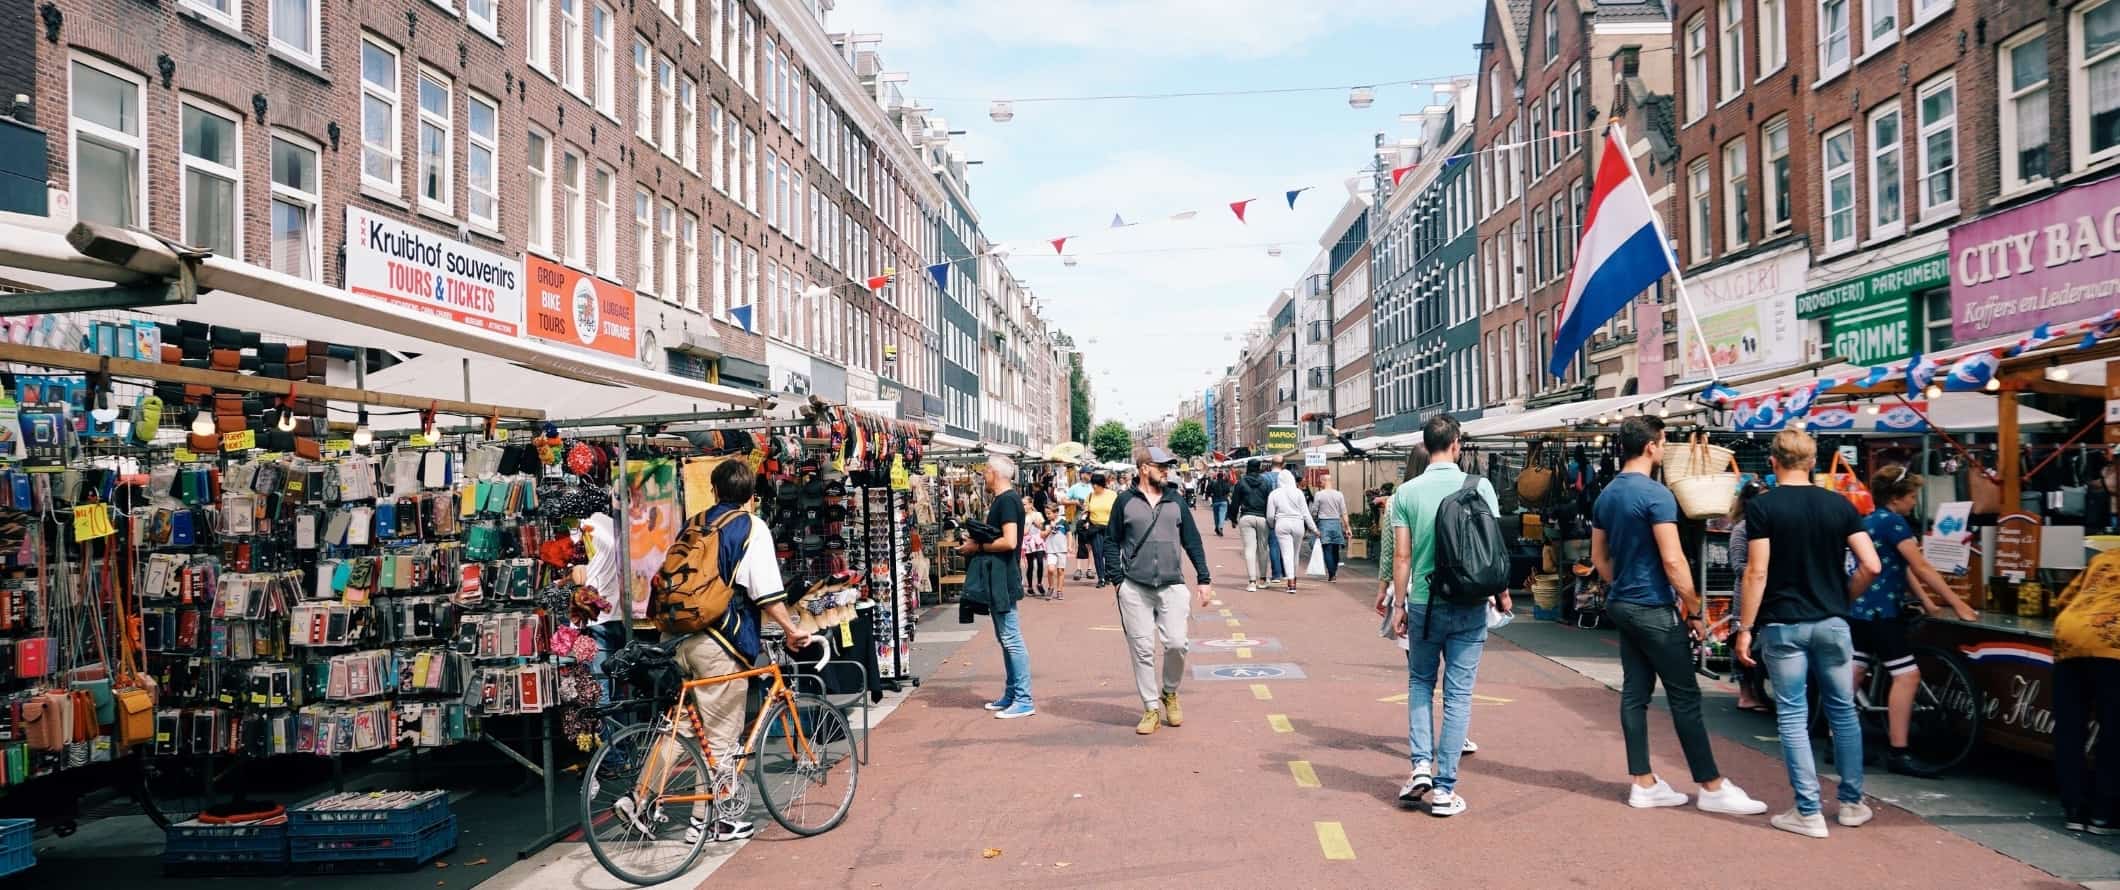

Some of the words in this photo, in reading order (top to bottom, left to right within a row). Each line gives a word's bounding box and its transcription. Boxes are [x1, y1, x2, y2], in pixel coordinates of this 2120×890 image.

[370, 220, 442, 268] Kruithof
[446, 251, 515, 290] souvenirs
[1959, 230, 2038, 287] CITY
[387, 261, 432, 298] TOURS
[435, 274, 445, 301] &
[447, 278, 495, 313] TICKETS
[537, 266, 565, 289] GROUP
[541, 289, 561, 312] BIKE
[603, 299, 630, 321] LUGGAGE
[1798, 280, 1865, 313] DROGISTERIJ
[1962, 295, 2018, 330] Koffers
[2019, 295, 2039, 313] en
[538, 312, 566, 335] TOURS
[1834, 320, 1908, 365] GRIMME
